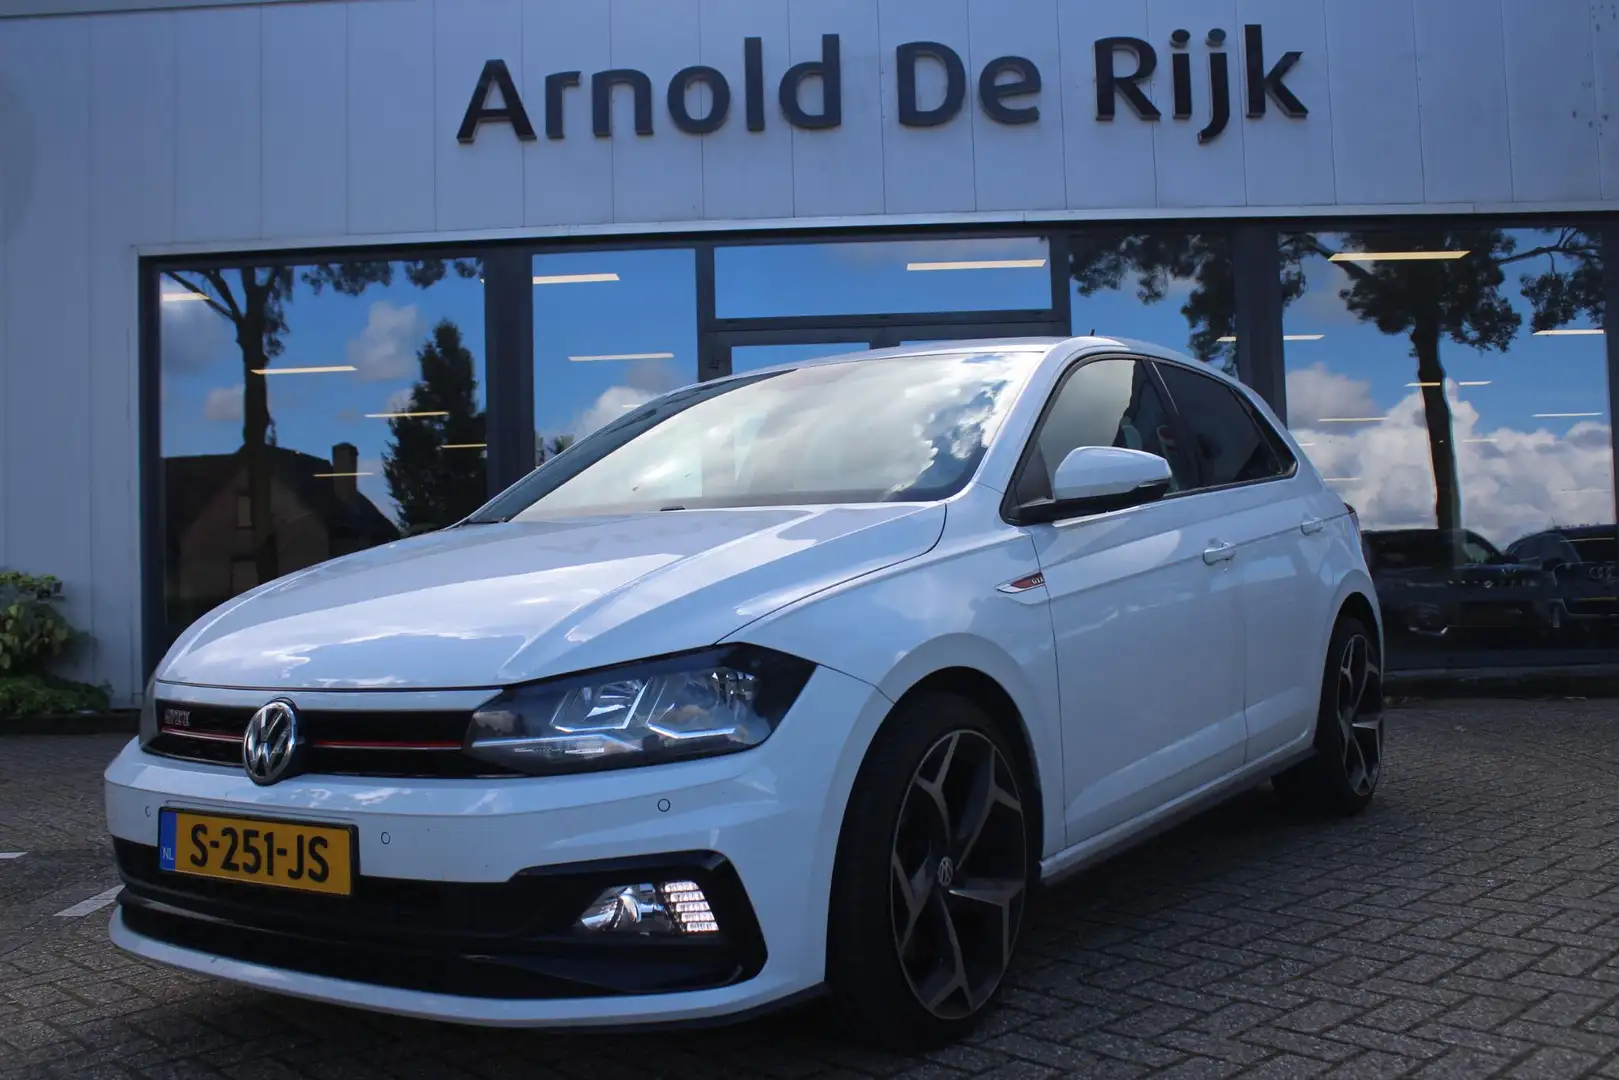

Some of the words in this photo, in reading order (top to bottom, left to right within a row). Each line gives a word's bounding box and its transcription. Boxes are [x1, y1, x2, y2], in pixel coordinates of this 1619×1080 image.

[457, 34, 841, 143] Arnold
[896, 42, 1042, 128] De
[1092, 24, 1309, 144] Rijk
[162, 847, 174, 861] NL
[190, 823, 329, 883] S-251-JS
